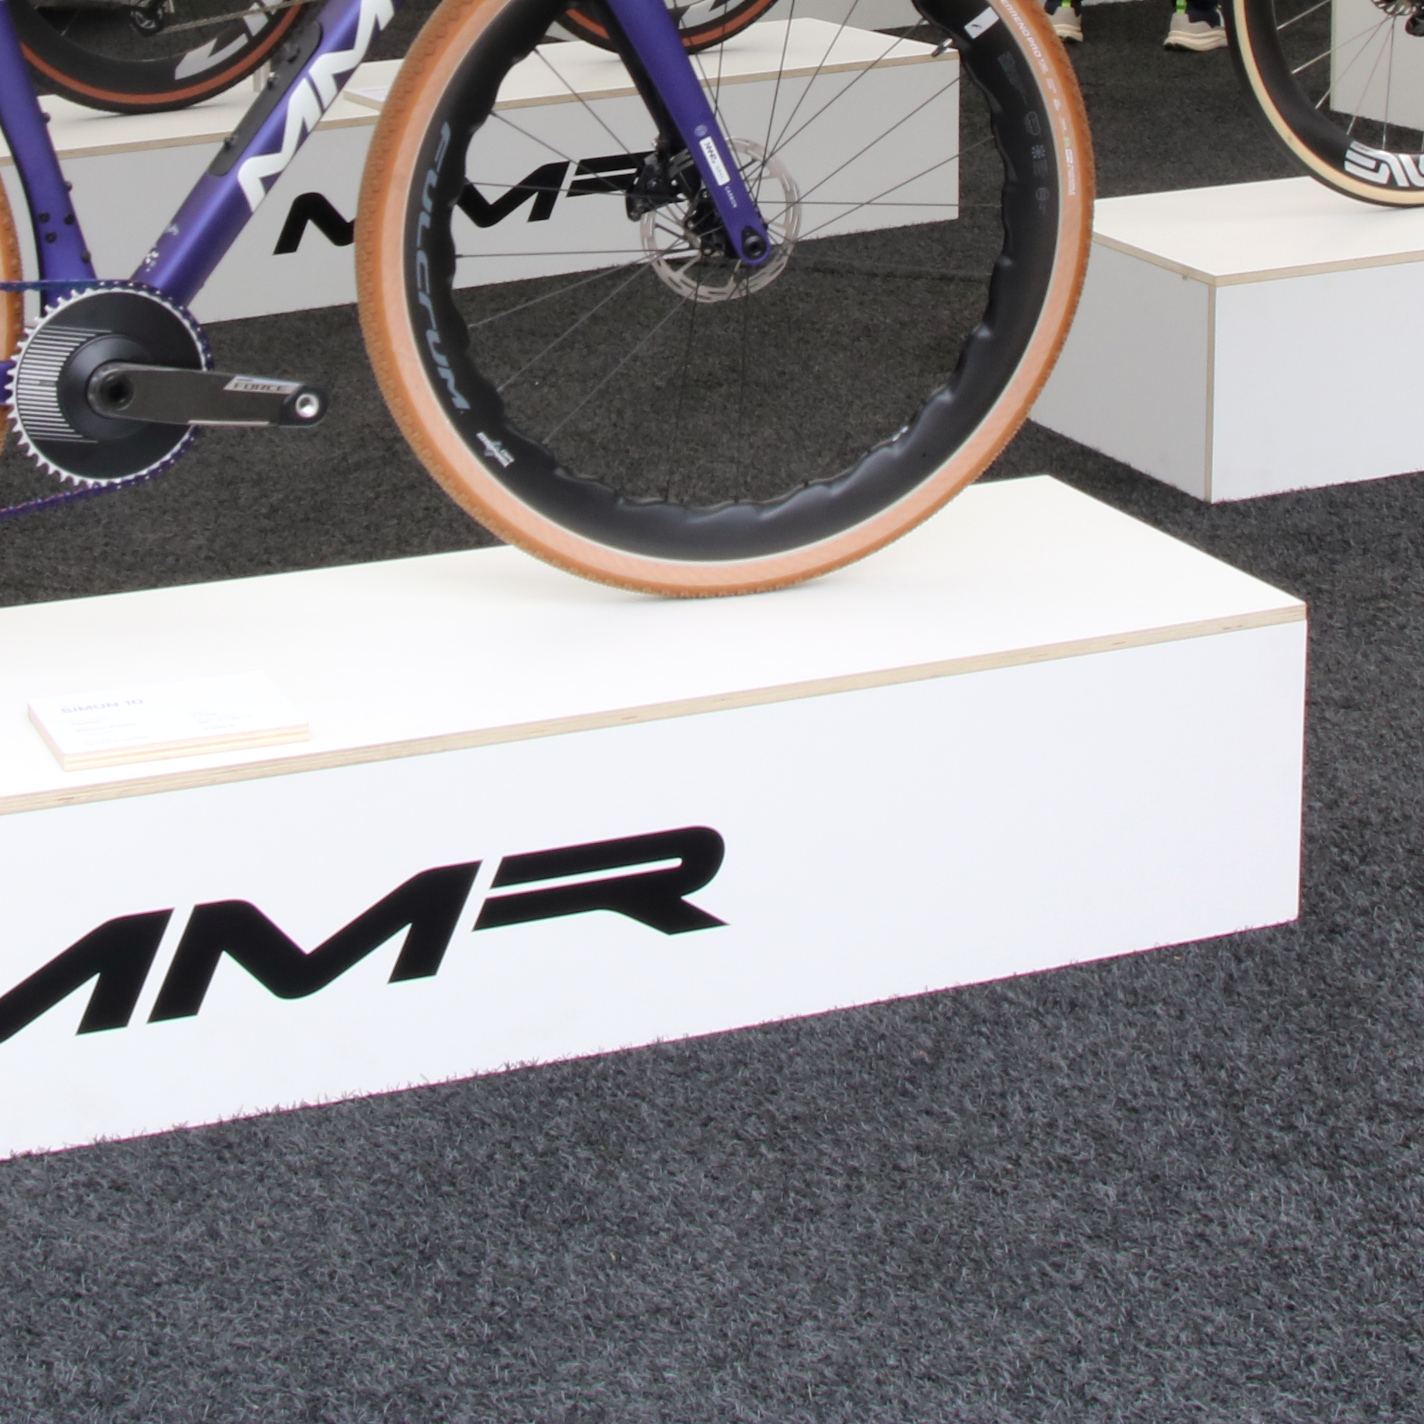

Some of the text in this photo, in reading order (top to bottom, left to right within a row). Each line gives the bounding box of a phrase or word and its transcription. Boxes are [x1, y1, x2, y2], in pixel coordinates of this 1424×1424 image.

[1026, 35, 1043, 59] PRO
[724, 185, 738, 209] CARBON
[415, 121, 472, 412] FULCRUM
[234, 382, 288, 392] FORCE
[60, 697, 144, 714] SIMUN 10
